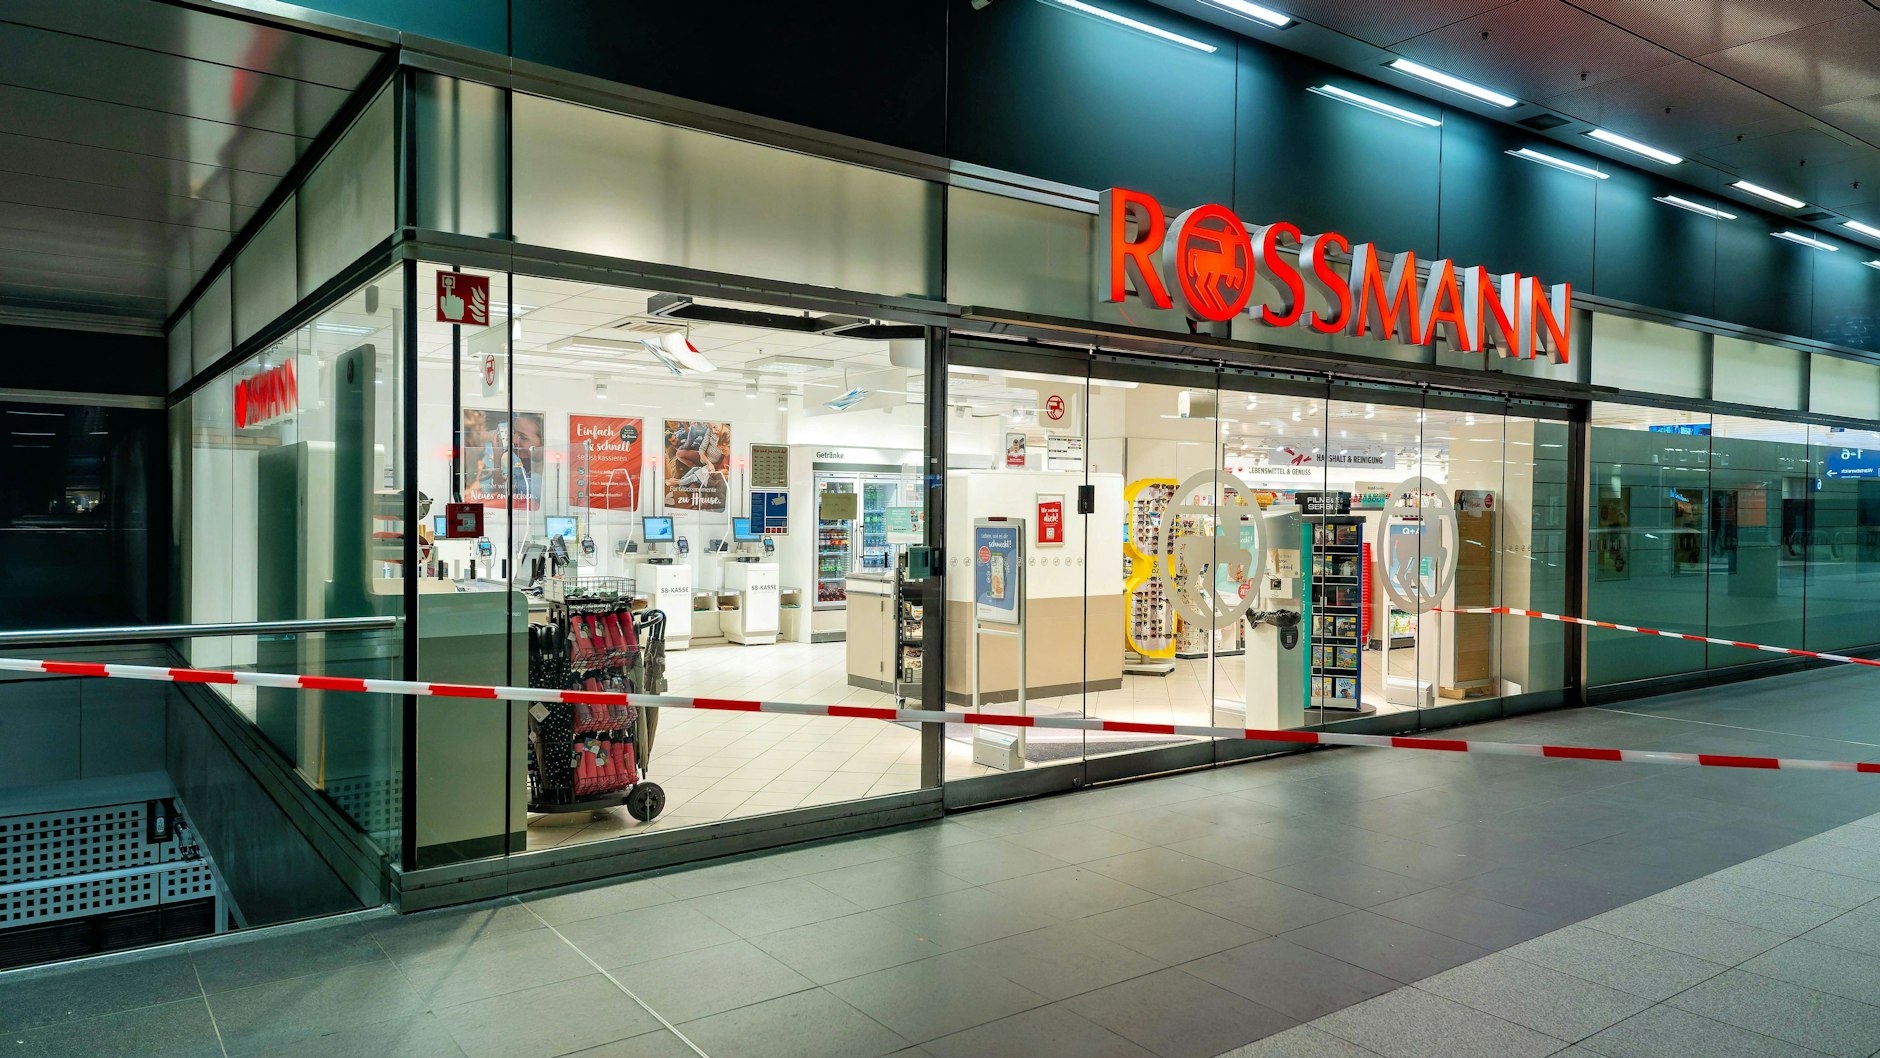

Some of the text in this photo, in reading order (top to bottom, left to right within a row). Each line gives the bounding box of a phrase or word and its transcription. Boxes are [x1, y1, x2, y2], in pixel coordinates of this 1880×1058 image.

[1104, 187, 1571, 365] ROSSMANN
[577, 424, 615, 439] Einfach
[596, 440, 631, 452] schnell
[816, 451, 844, 460] Getränke
[1316, 454, 1346, 462] HASHALT
[1353, 455, 1383, 464] REINIGUNG
[1248, 466, 1311, 476] LEBENSMITTEL & GENUSS
[470, 490, 538, 500] Neues eneckn.
[678, 492, 722, 506] zu Hause.
[1044, 513, 1059, 522] dich!
